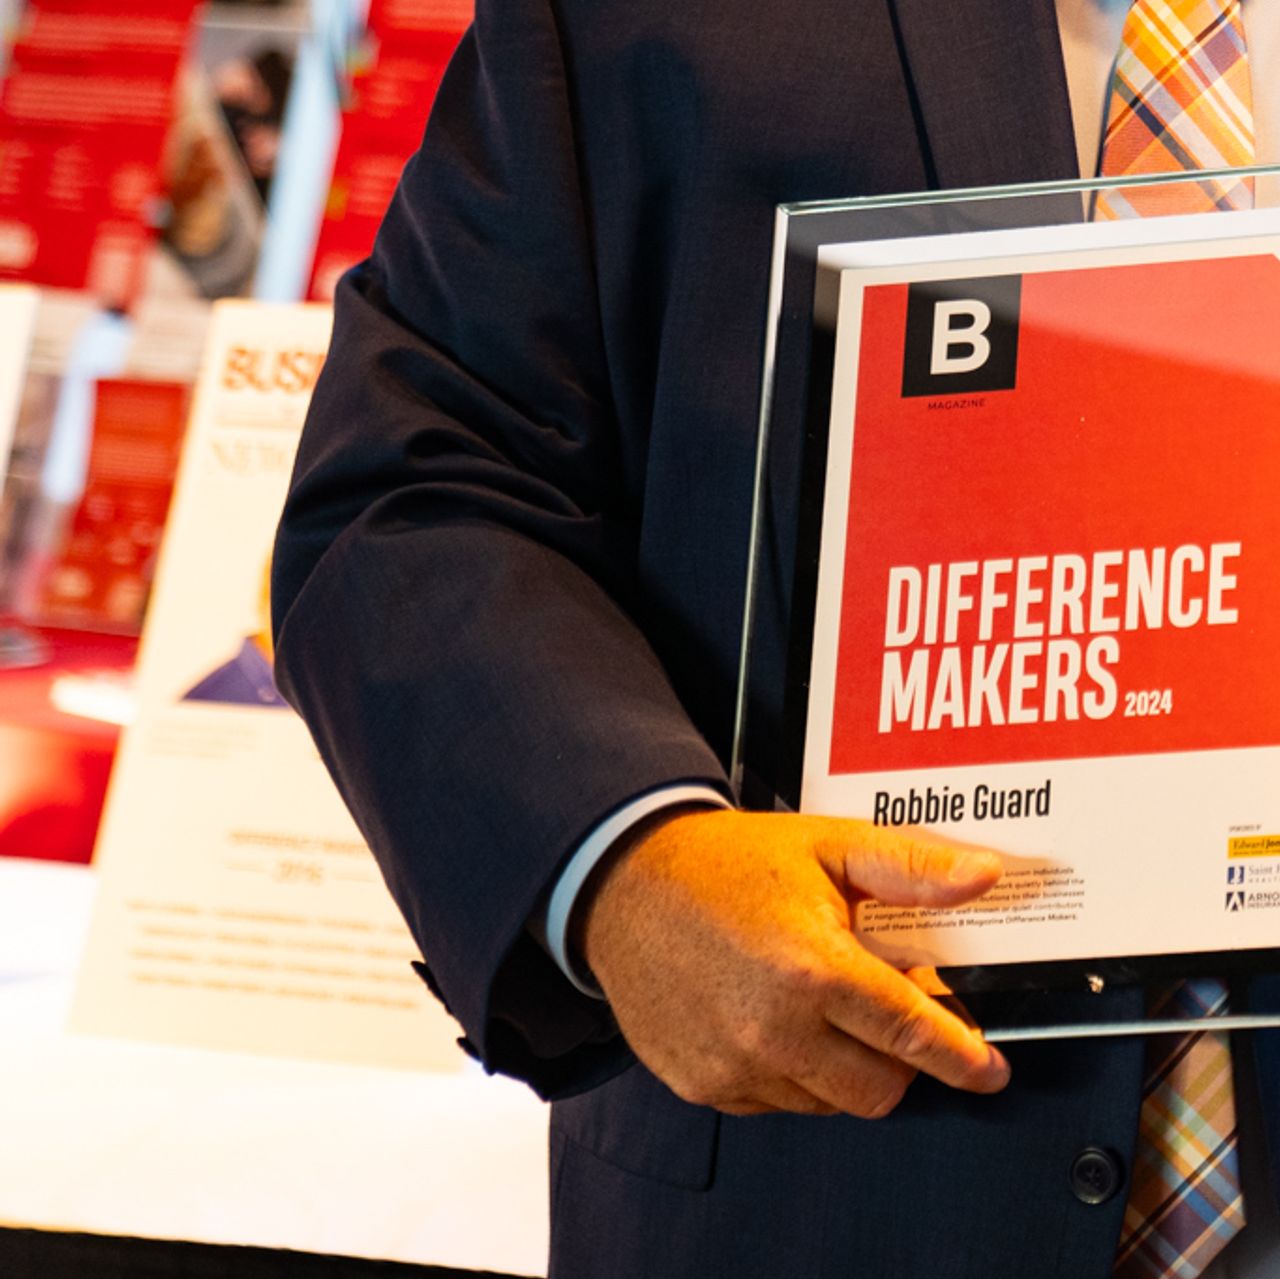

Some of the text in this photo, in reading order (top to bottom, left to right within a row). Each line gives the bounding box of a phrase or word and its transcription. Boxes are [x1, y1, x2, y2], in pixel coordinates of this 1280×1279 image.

[930, 299, 991, 375] B
[928, 398, 986, 410] MAGAZINE
[884, 542, 1241, 647] DIFFERENCE
[877, 635, 1173, 733] MAKERS 2024
[873, 779, 1051, 827] Robbie Guard
